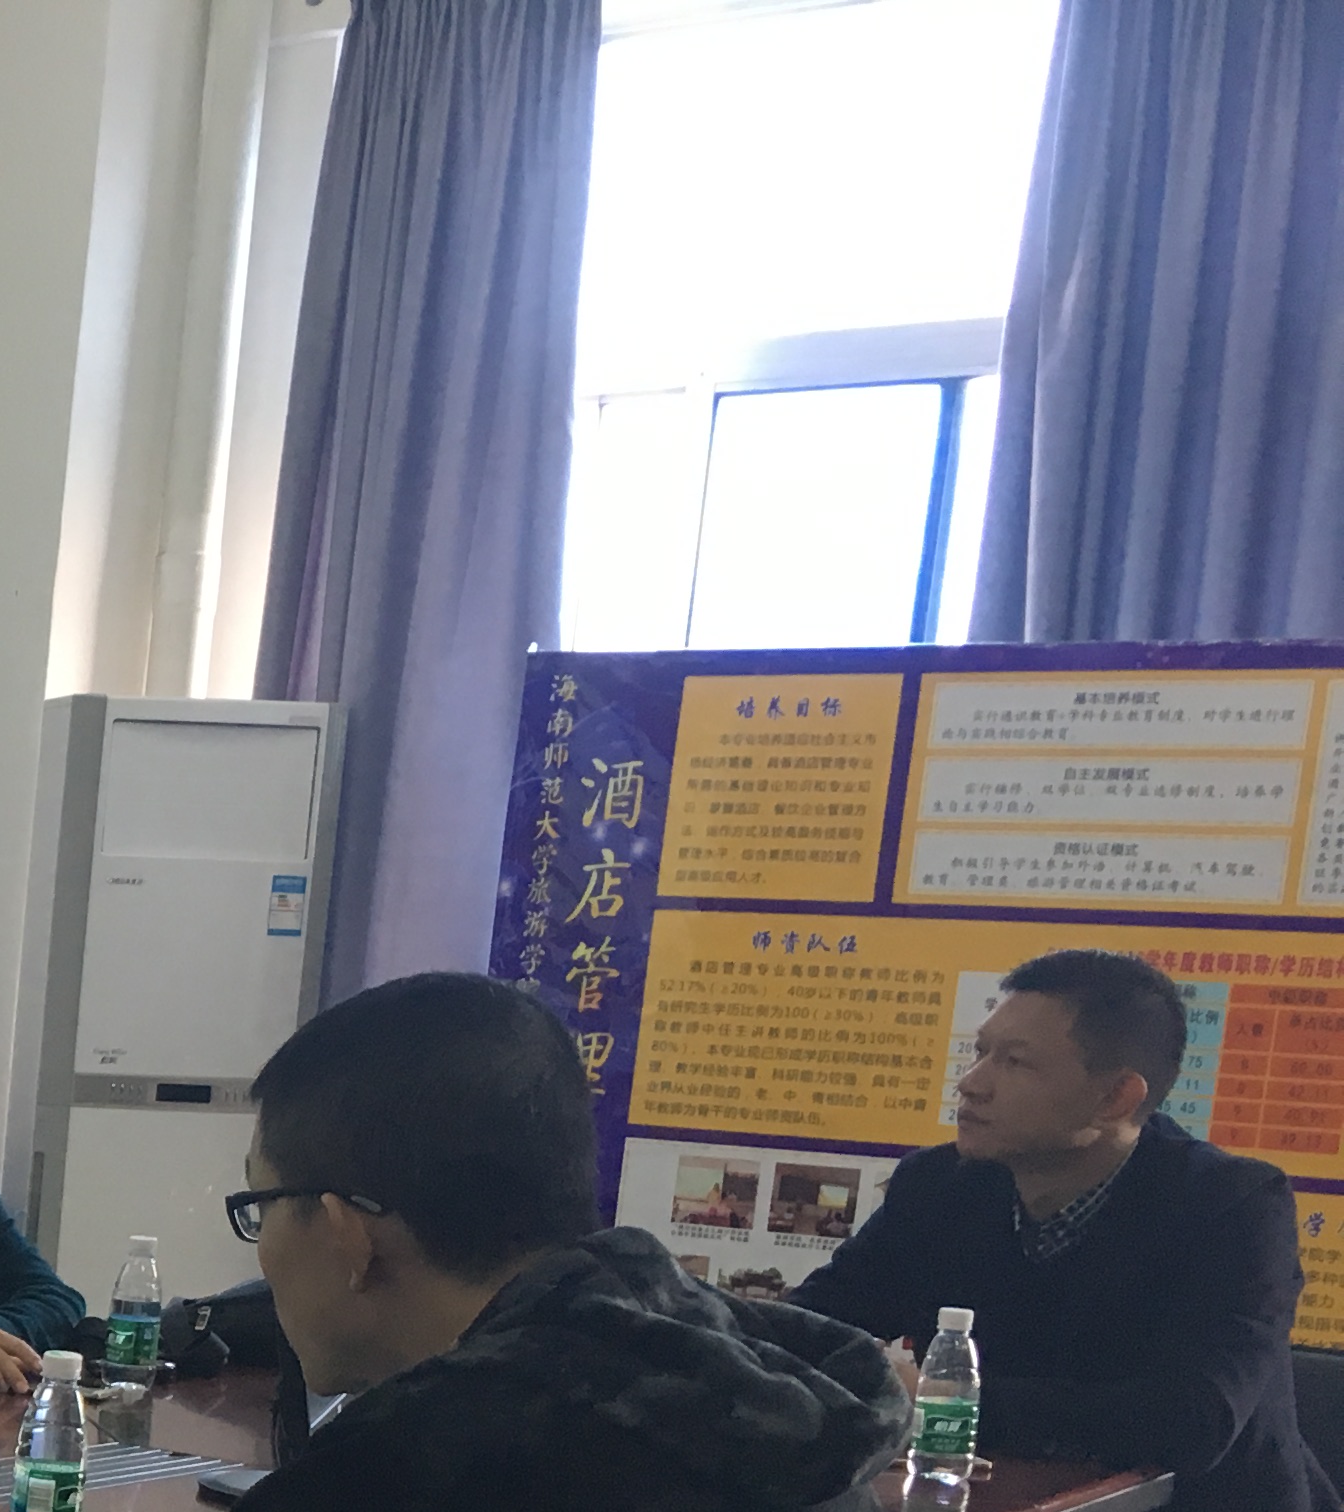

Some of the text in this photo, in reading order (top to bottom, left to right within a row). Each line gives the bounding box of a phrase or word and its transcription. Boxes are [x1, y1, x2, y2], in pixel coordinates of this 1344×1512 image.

[1073, 691, 1161, 706] 基本培养模式
[736, 695, 843, 721] 培养目标
[1063, 767, 1151, 782] 自主发展模式
[1053, 842, 1140, 857] 资格认证模式
[752, 930, 859, 954] 师资队伍
